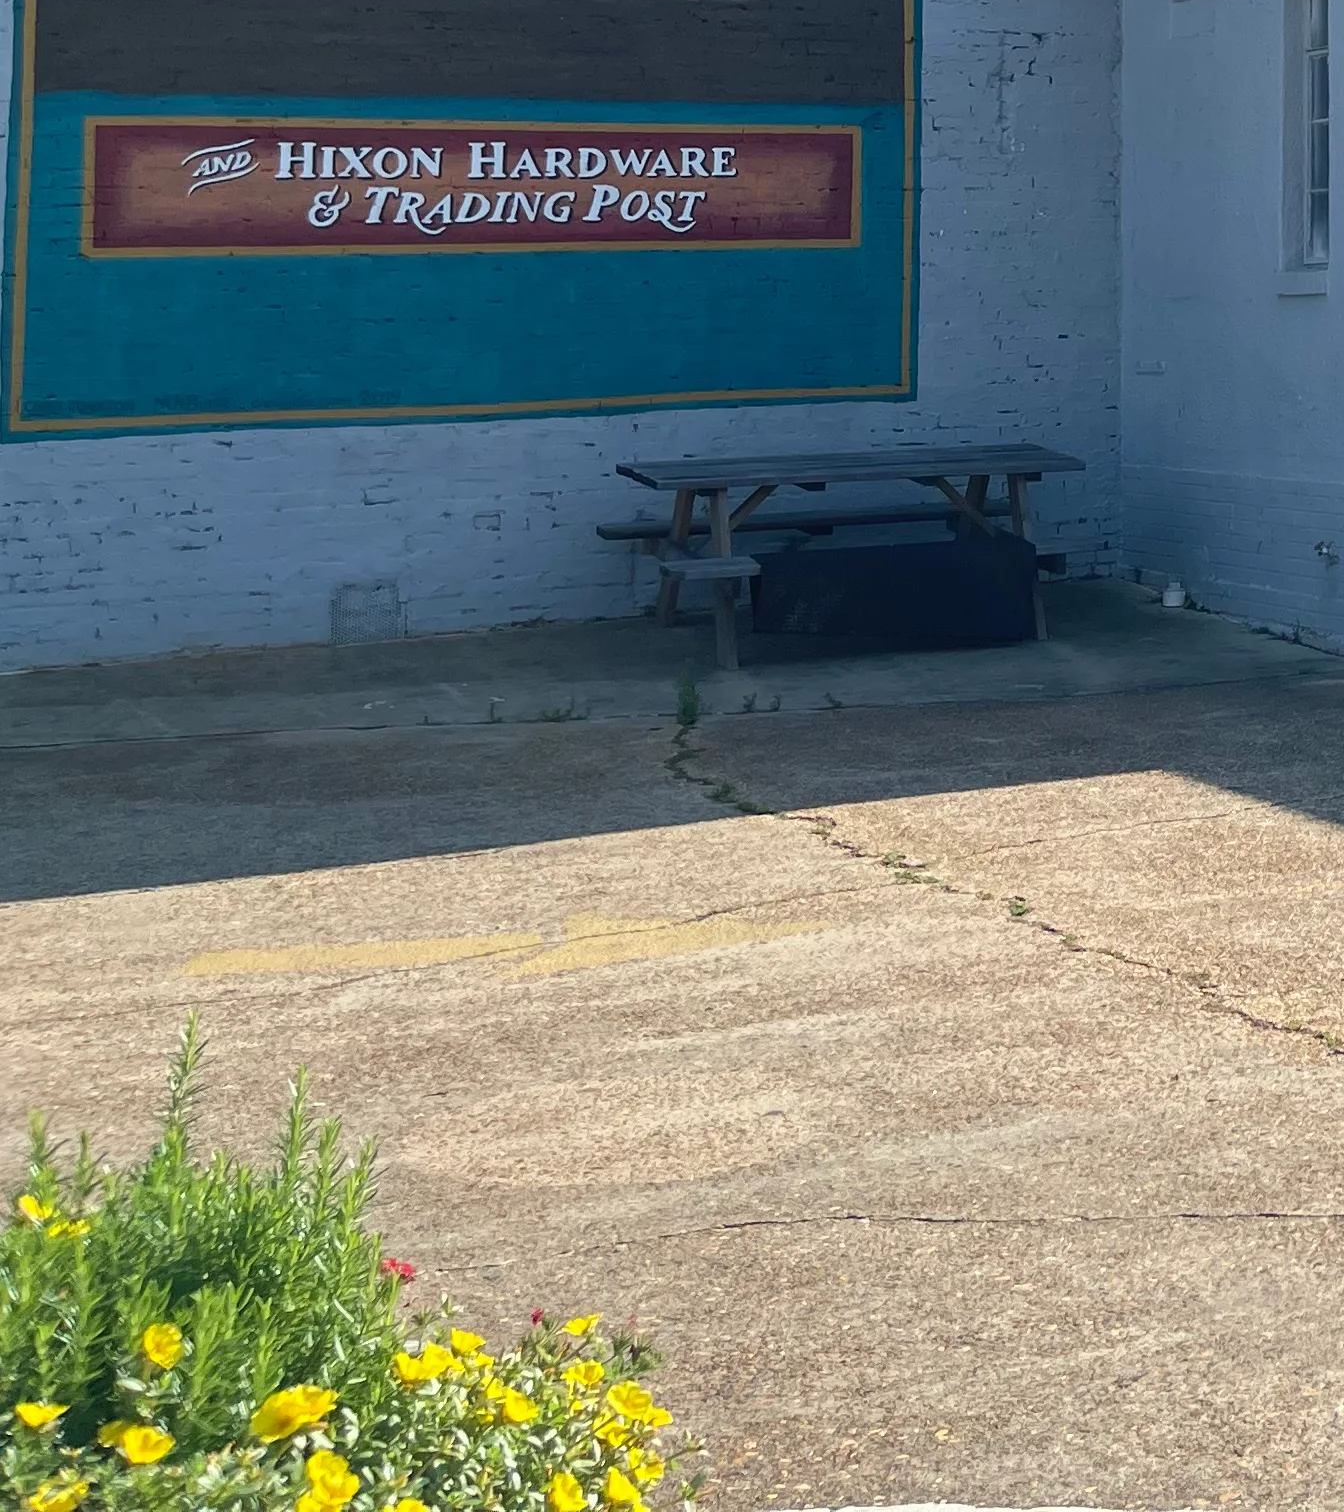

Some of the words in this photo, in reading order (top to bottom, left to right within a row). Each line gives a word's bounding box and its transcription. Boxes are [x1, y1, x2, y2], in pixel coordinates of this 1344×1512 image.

[191, 148, 251, 179] AND
[275, 141, 444, 181] HIXON
[467, 141, 739, 181] HARDWARE
[308, 185, 351, 227] &
[363, 184, 575, 237] TRADING
[583, 183, 708, 233] POST
